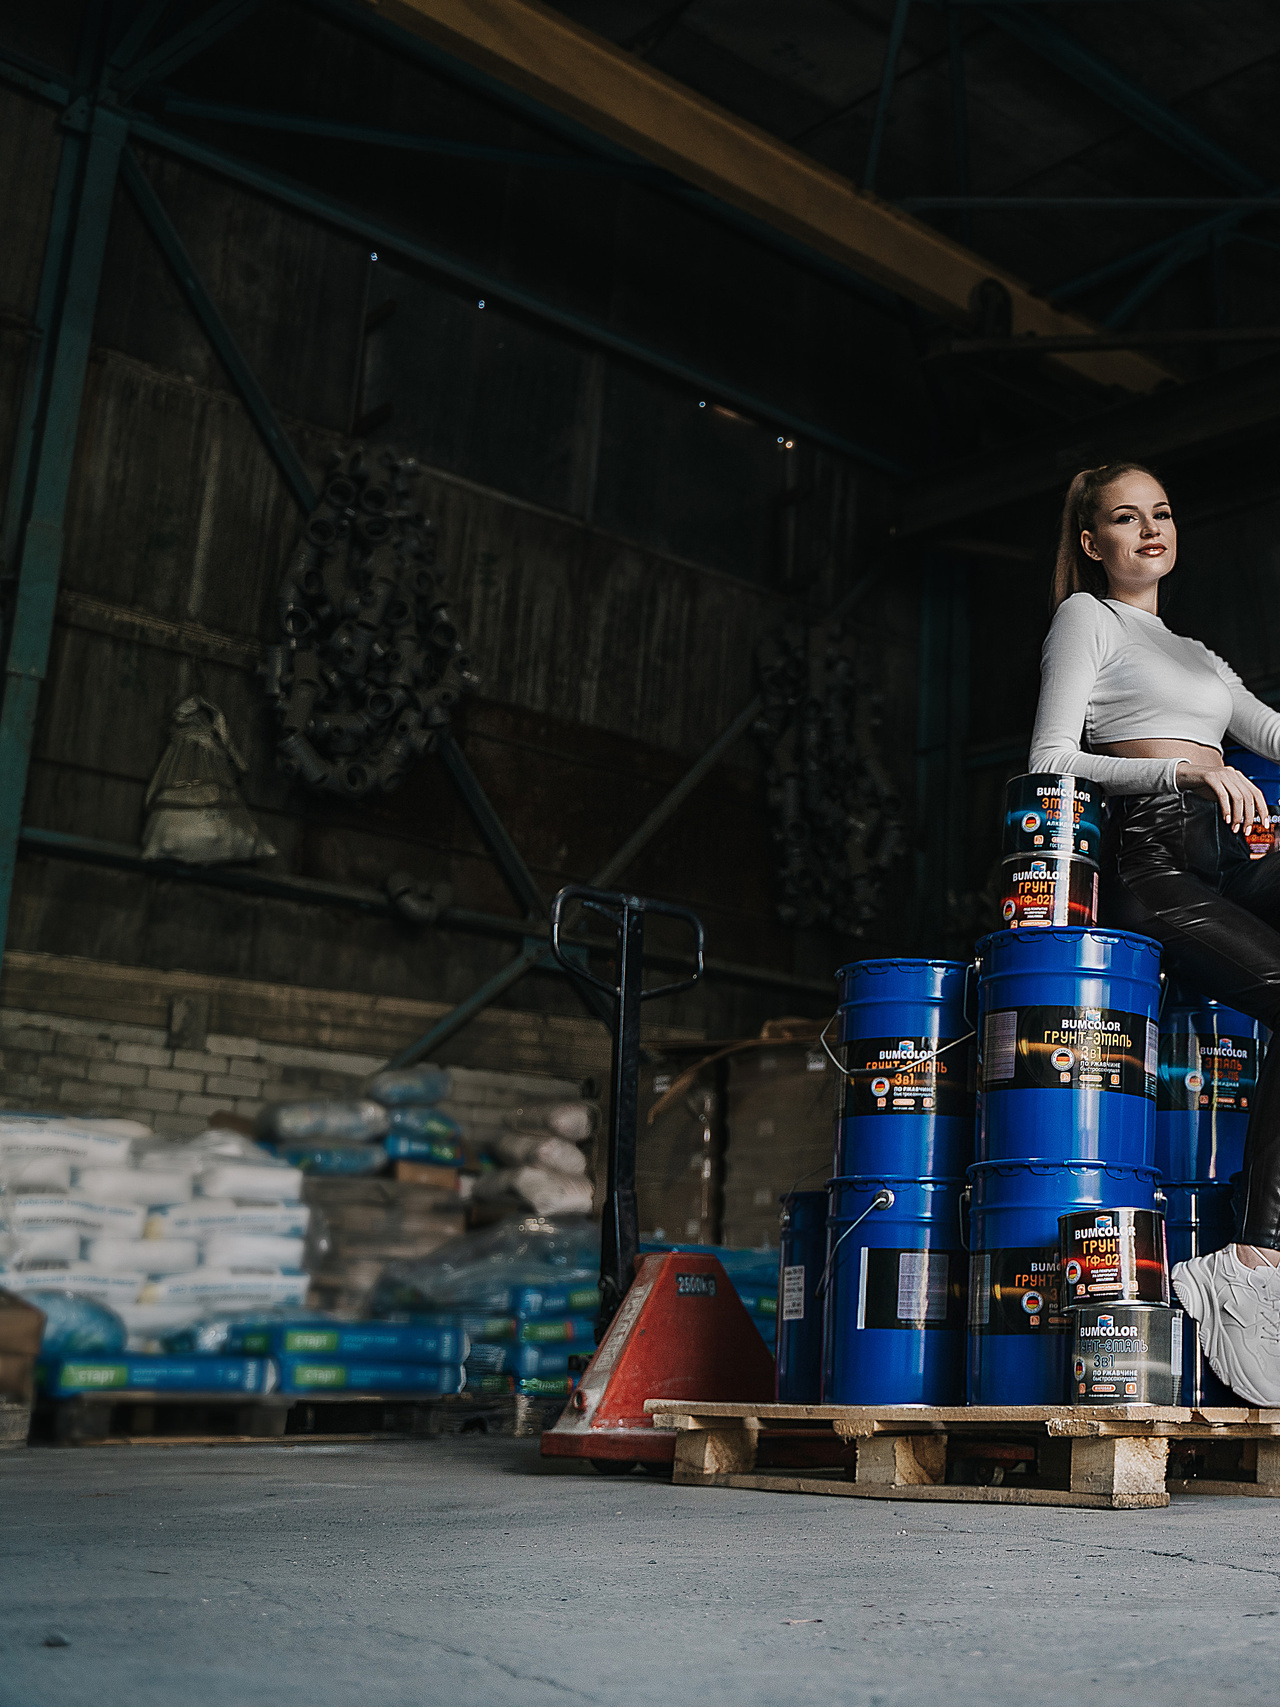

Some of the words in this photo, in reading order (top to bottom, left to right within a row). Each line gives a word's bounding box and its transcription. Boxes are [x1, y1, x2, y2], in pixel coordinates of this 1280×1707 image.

[1036, 786, 1091, 803] BUMCLOR
[1012, 870, 1067, 882] BUMCOLO
[1018, 881, 1057, 894] ГРУНТ
[1019, 894, 1055, 905] ГФ-021
[1061, 1020, 1121, 1032] BUMCOLOR
[1043, 1030, 1133, 1048] ГРУНТ-ЭМАЛЬ
[879, 1050, 935, 1060] BUMCOLOR
[1200, 1047, 1248, 1059] BUMCOLOR
[894, 1073, 915, 1086] 3в1
[1074, 1226, 1136, 1240] BUMCOLOR
[1031, 1262, 1061, 1272] BUMC
[1015, 1274, 1061, 1287] ГРУНТ-
[1080, 1326, 1138, 1337] BUMCOLOR
[1080, 1338, 1149, 1353] УНТ-ЭМАЛЬ
[1093, 1353, 1116, 1368] 3в1
[78, 1368, 116, 1385] старт
